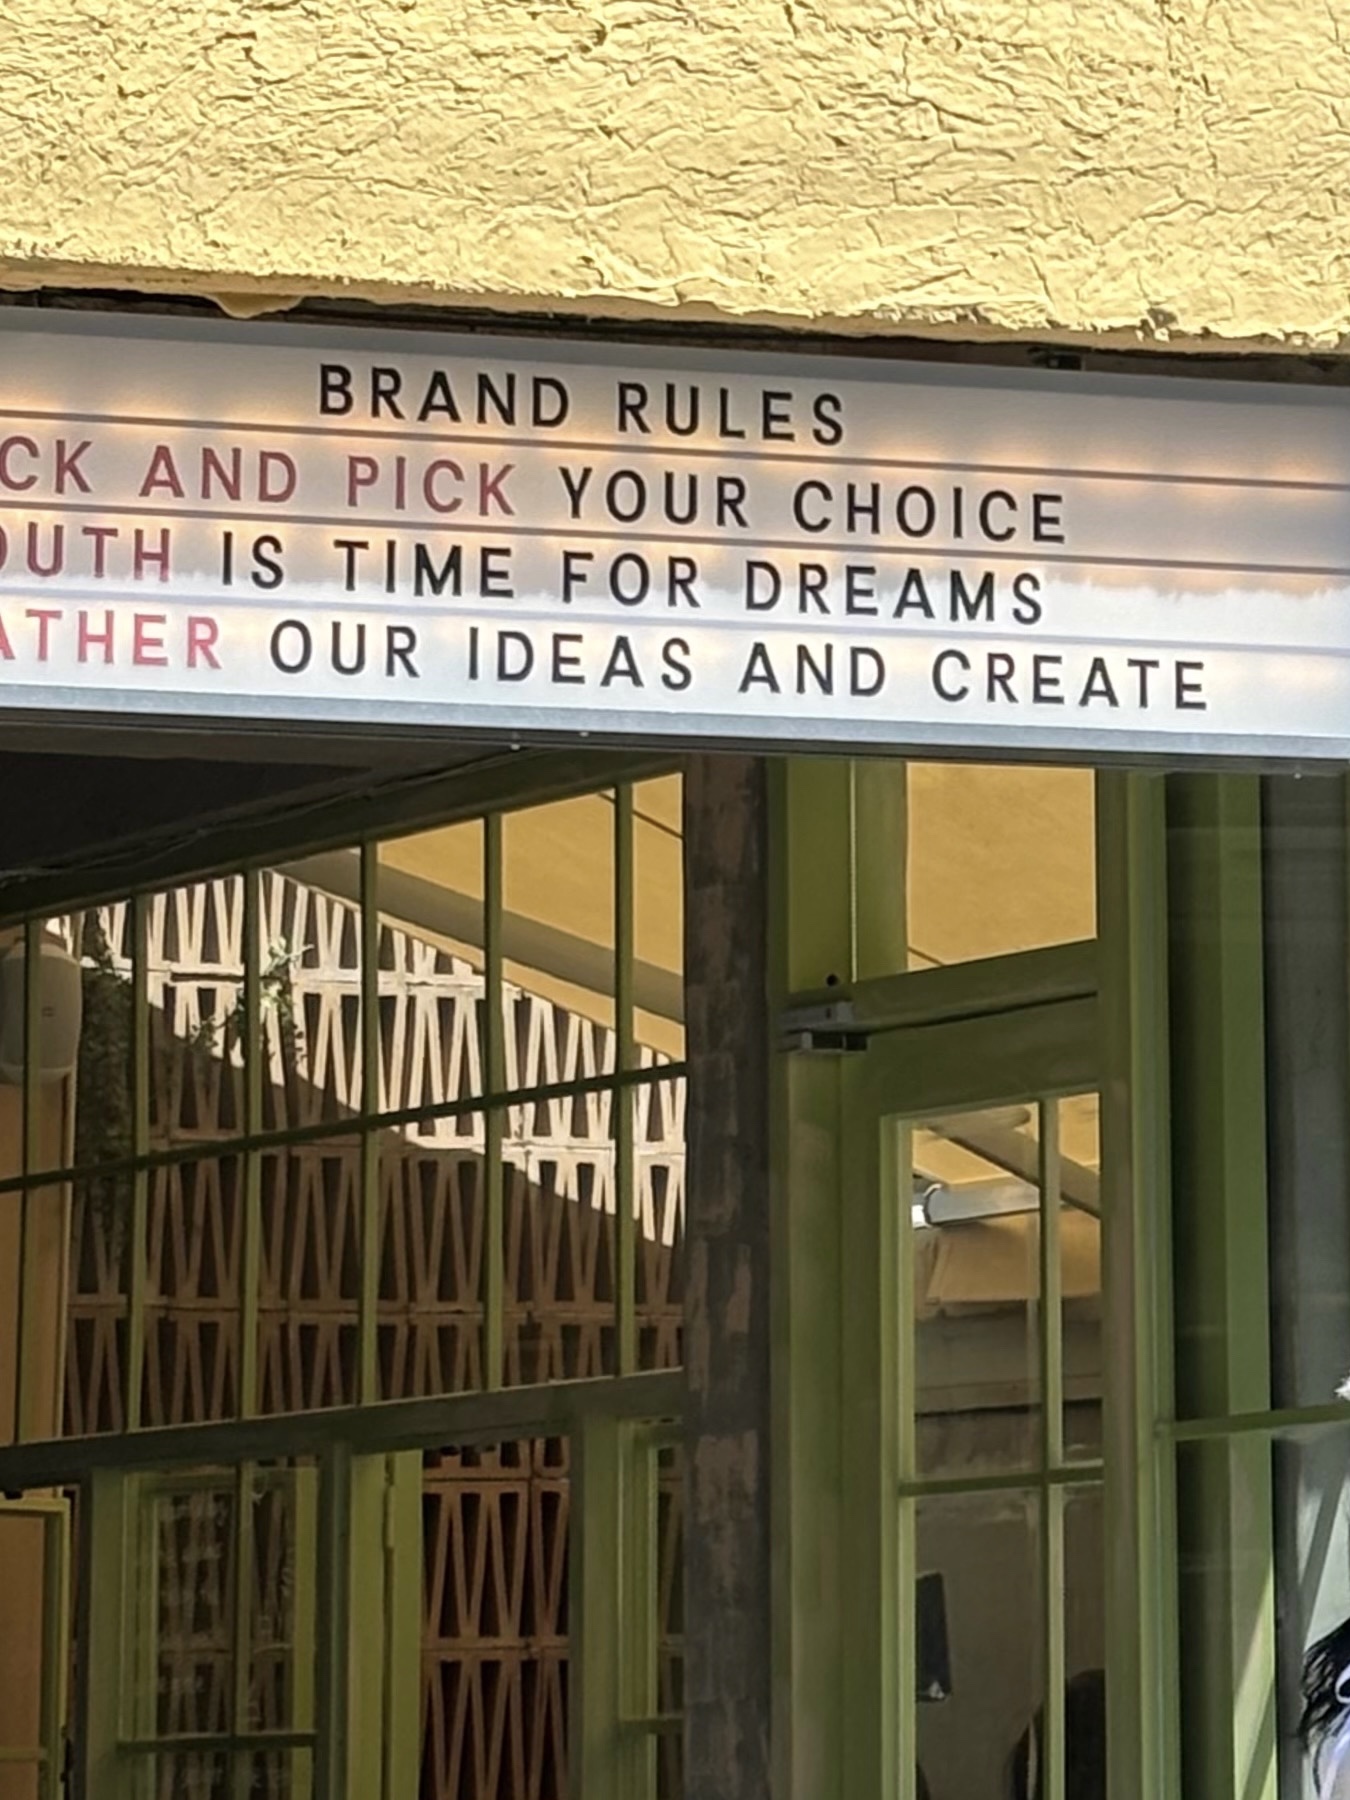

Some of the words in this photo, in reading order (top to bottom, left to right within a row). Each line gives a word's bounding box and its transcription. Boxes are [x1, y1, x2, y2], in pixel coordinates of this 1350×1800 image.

[318, 363, 571, 428] BRAND
[617, 381, 845, 446] RULES
[138, 442, 298, 504] AND
[347, 454, 518, 517] PICK
[559, 465, 750, 529] YOUR
[793, 478, 1066, 545] CHOICE
[0, 521, 172, 583] UTH
[221, 530, 286, 591] IS
[333, 538, 516, 599] TIME
[560, 548, 701, 609] FOR
[746, 559, 1044, 626] DREAMS
[268, 617, 422, 680] OUR
[467, 625, 693, 693] IDEAS
[738, 640, 888, 699] AND
[930, 647, 1208, 712] CREATE
